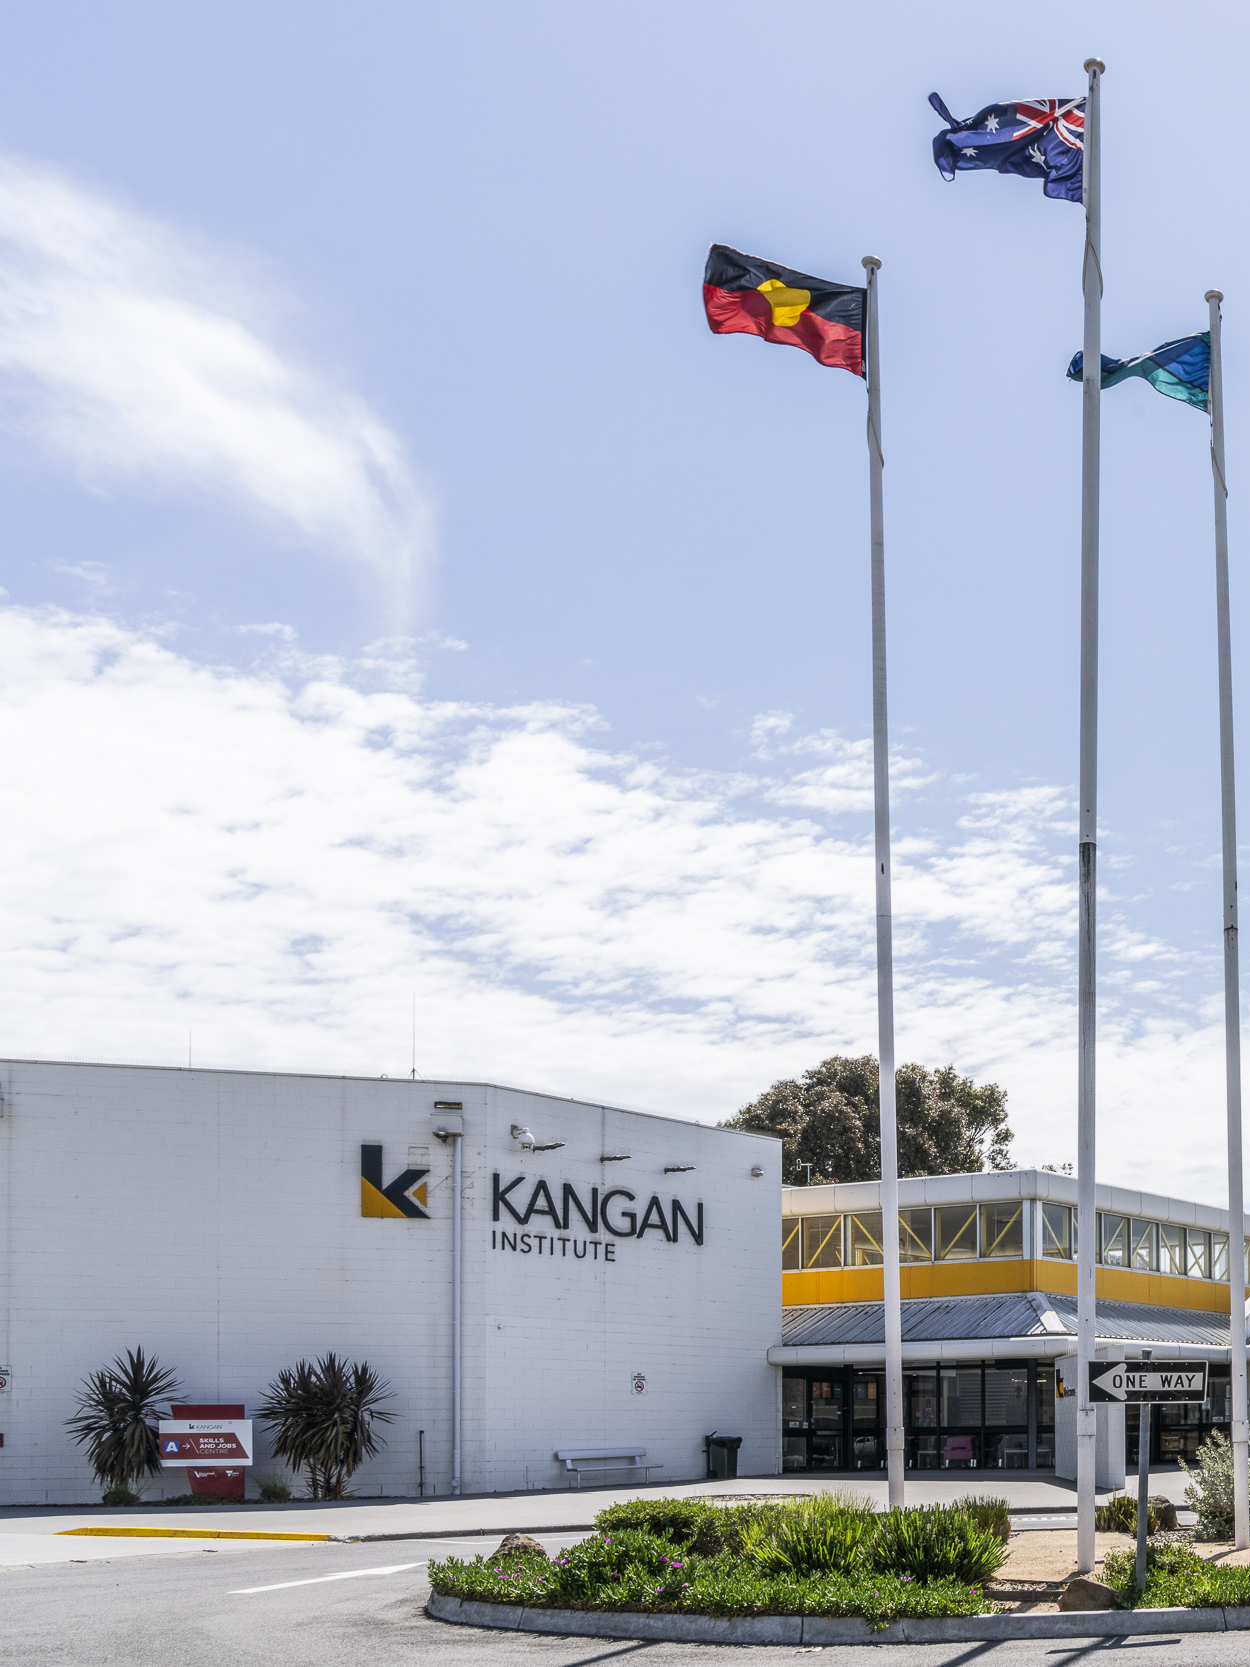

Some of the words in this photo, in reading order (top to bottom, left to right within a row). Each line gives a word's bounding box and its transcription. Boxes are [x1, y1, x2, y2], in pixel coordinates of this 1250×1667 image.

[492, 1172, 704, 1246] KANGAN
[492, 1230, 616, 1262] INSTITUTE
[1112, 1374, 1148, 1389] ONE
[1160, 1374, 1197, 1389] WAY
[166, 1441, 178, 1452] A
